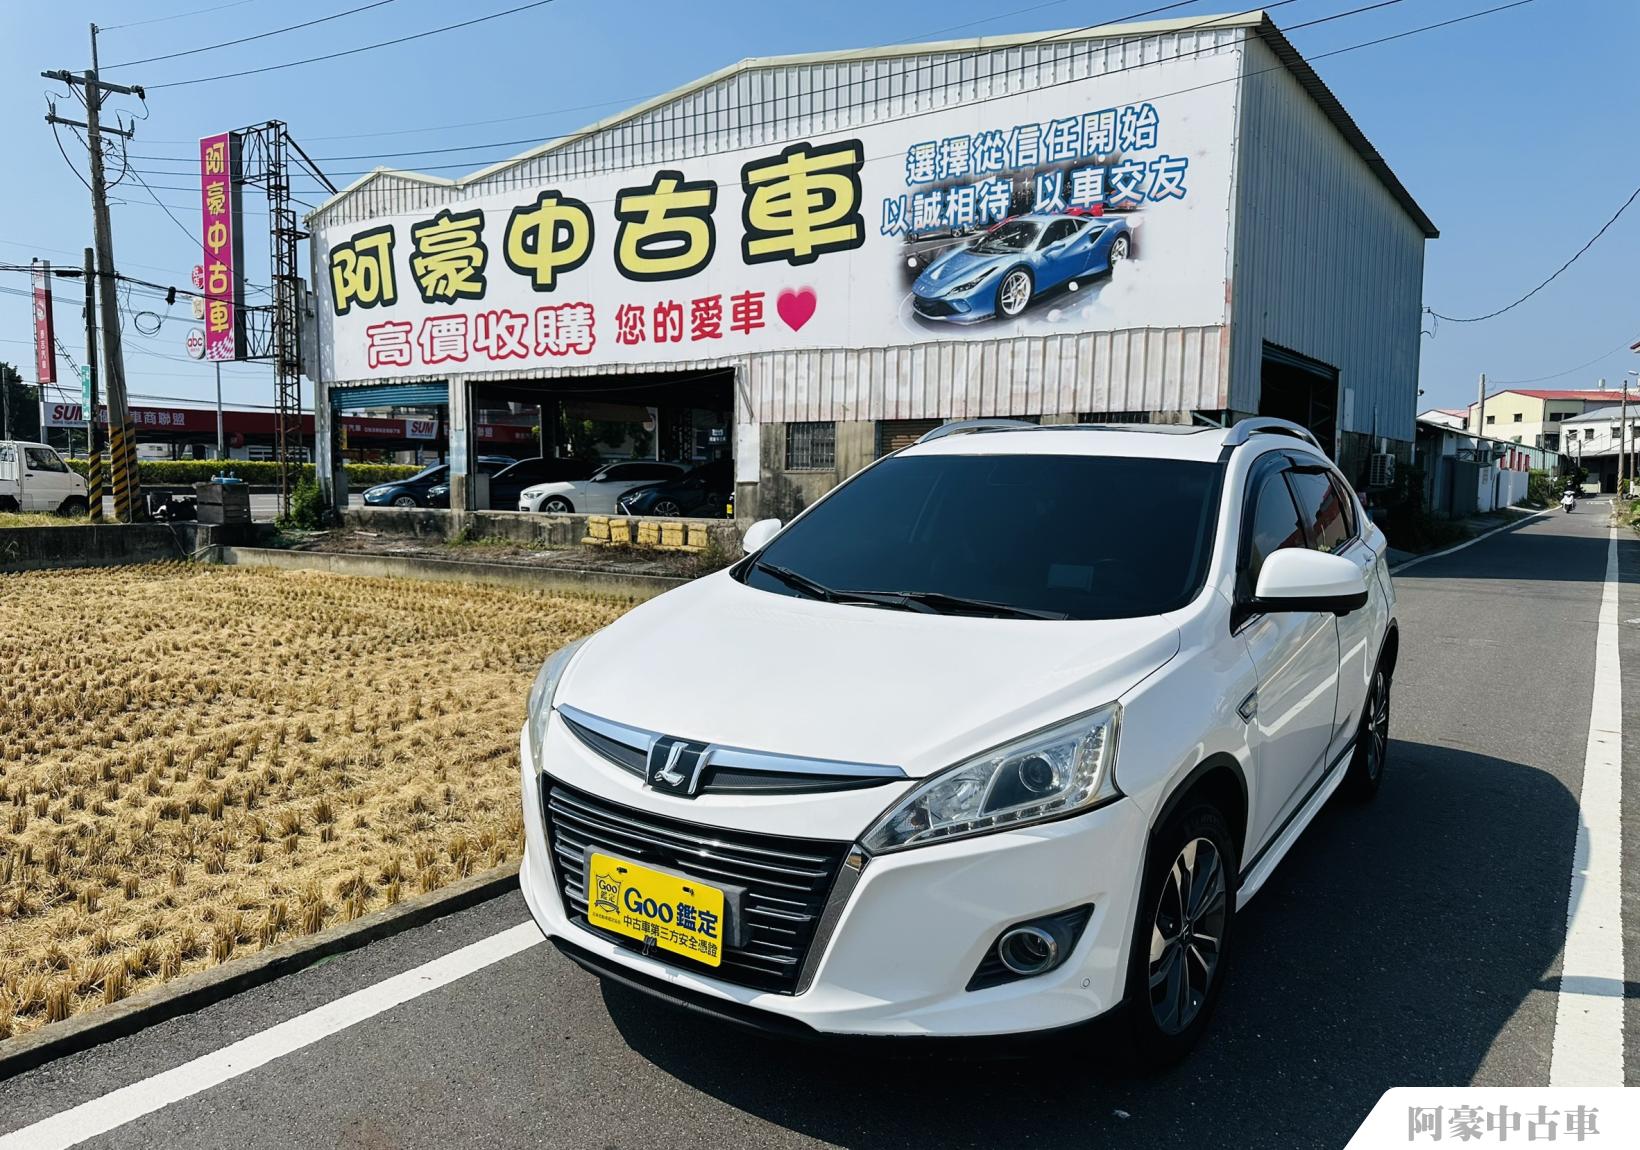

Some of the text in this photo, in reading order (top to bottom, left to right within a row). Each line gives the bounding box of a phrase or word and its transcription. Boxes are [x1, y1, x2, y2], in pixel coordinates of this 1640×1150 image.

[905, 103, 1159, 186] 選擇從信任開始
[329, 138, 865, 316] 阿豪中古車
[880, 154, 1189, 236] 以誠相待 以車交友
[205, 141, 229, 333] 阿豪中古車
[366, 290, 766, 369] 高價收購 您的愛車
[411, 420, 434, 434] SUM
[599, 880, 617, 893] Goo
[624, 887, 718, 939] Goo 鑑定
[623, 914, 717, 957] 中古車第三方安全憑證
